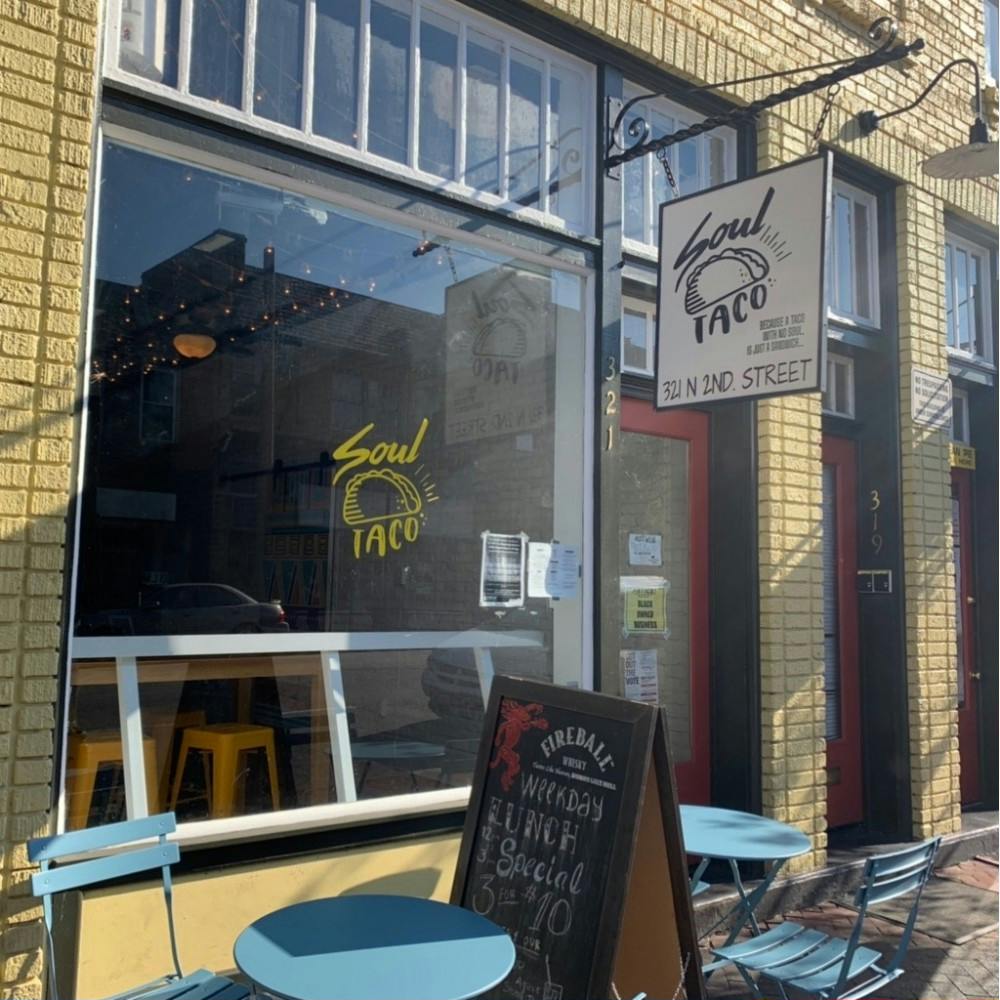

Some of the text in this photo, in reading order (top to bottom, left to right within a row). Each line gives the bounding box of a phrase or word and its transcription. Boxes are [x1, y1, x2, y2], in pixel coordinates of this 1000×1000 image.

[673, 187, 775, 293] Soul
[693, 284, 767, 344] TACO
[662, 380, 681, 401] 321
[687, 376, 697, 399] N
[742, 358, 812, 390] STREET
[332, 417, 429, 487] Soul
[353, 517, 419, 559] TACO
[487, 797, 580, 857] LUNCH
[496, 838, 584, 895] Special
